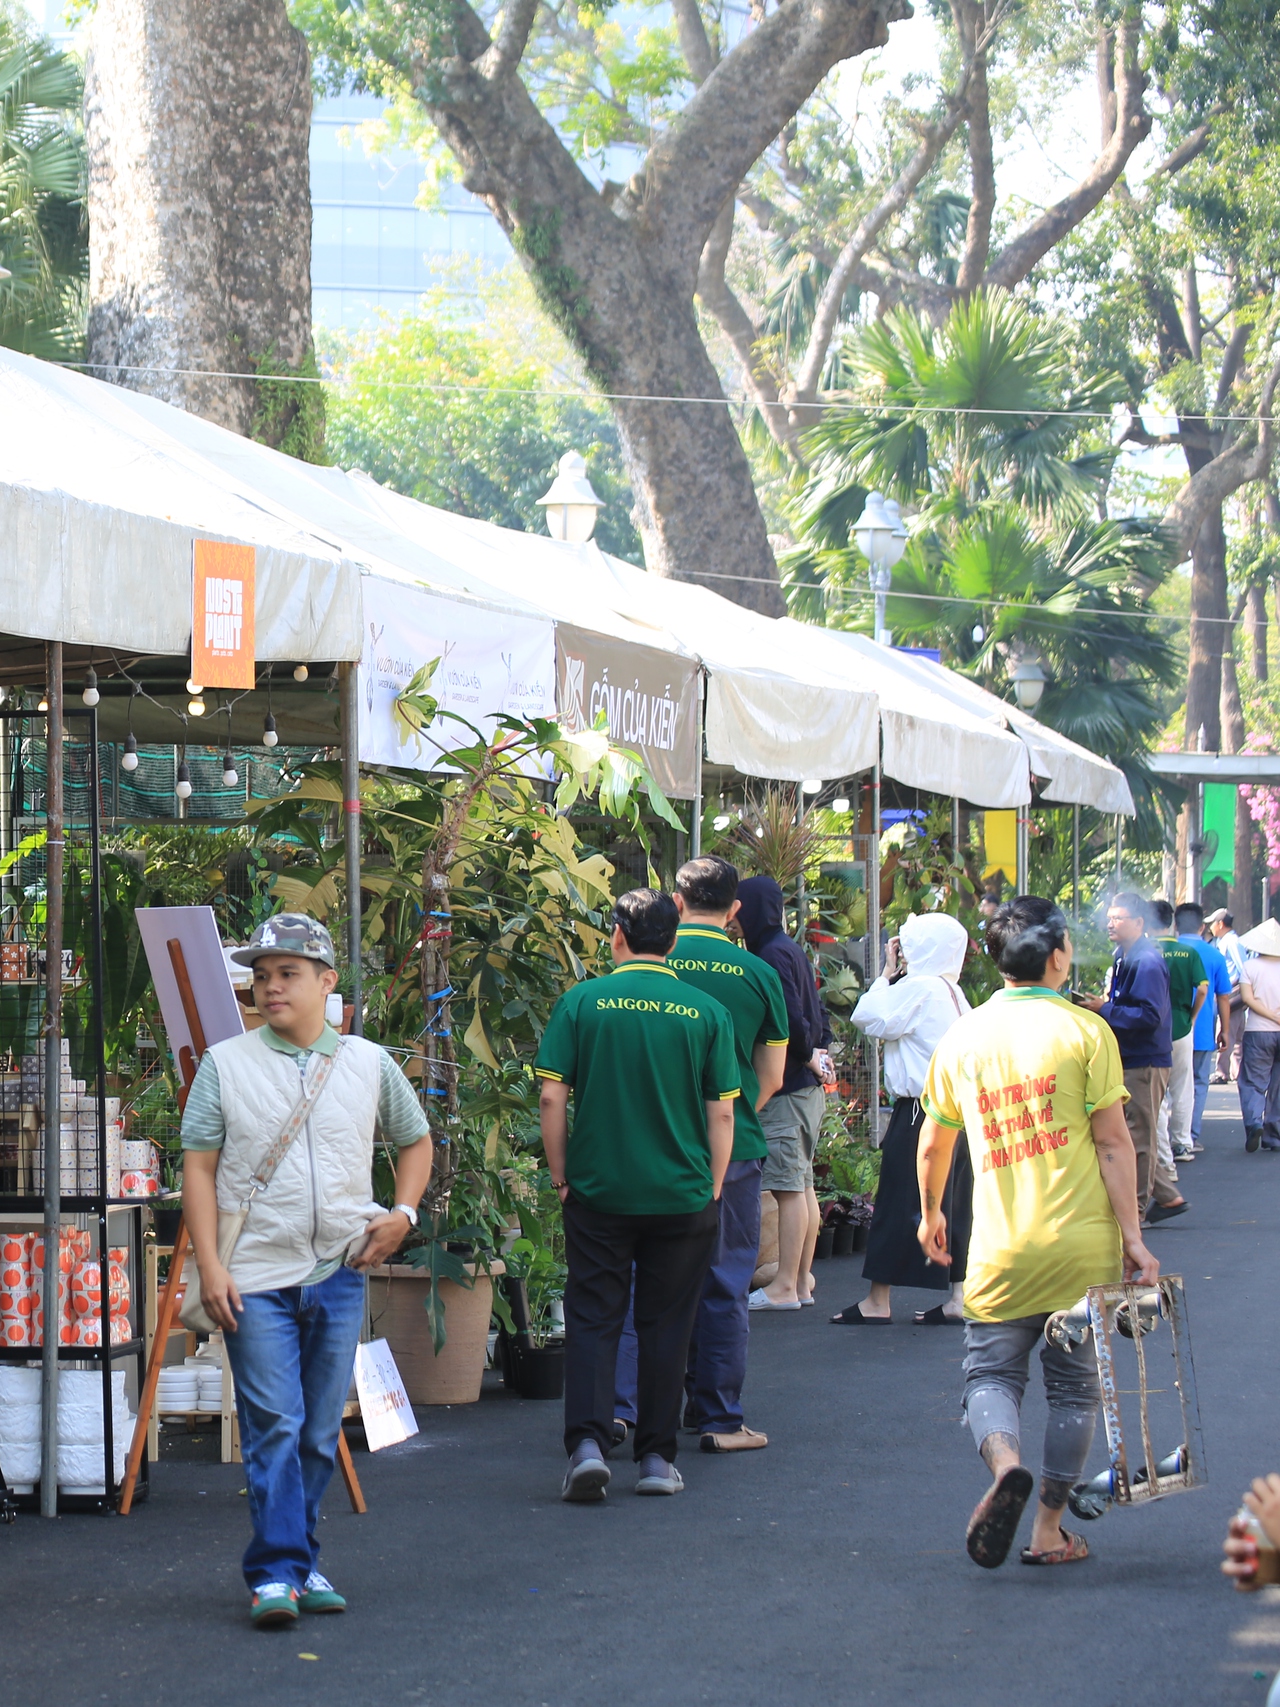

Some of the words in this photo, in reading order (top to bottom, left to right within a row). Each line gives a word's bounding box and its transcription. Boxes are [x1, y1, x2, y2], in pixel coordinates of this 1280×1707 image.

[205, 613, 242, 650] PLANT
[622, 678, 648, 745] CỦA
[647, 684, 679, 751] KIẾN
[260, 923, 276, 947] LA
[711, 961, 744, 977] ZOO
[1173, 950, 1189, 958] ZOO
[596, 998, 661, 1013] SAIGON
[664, 1002, 700, 1019] ZOO
[1002, 1073, 1057, 1107] TRÙNG
[982, 1117, 1004, 1144] BẬC
[1005, 1105, 1035, 1134] THẦY
[1036, 1098, 1054, 1125] VỀ
[1015, 1126, 1069, 1162] DƯỠNG
